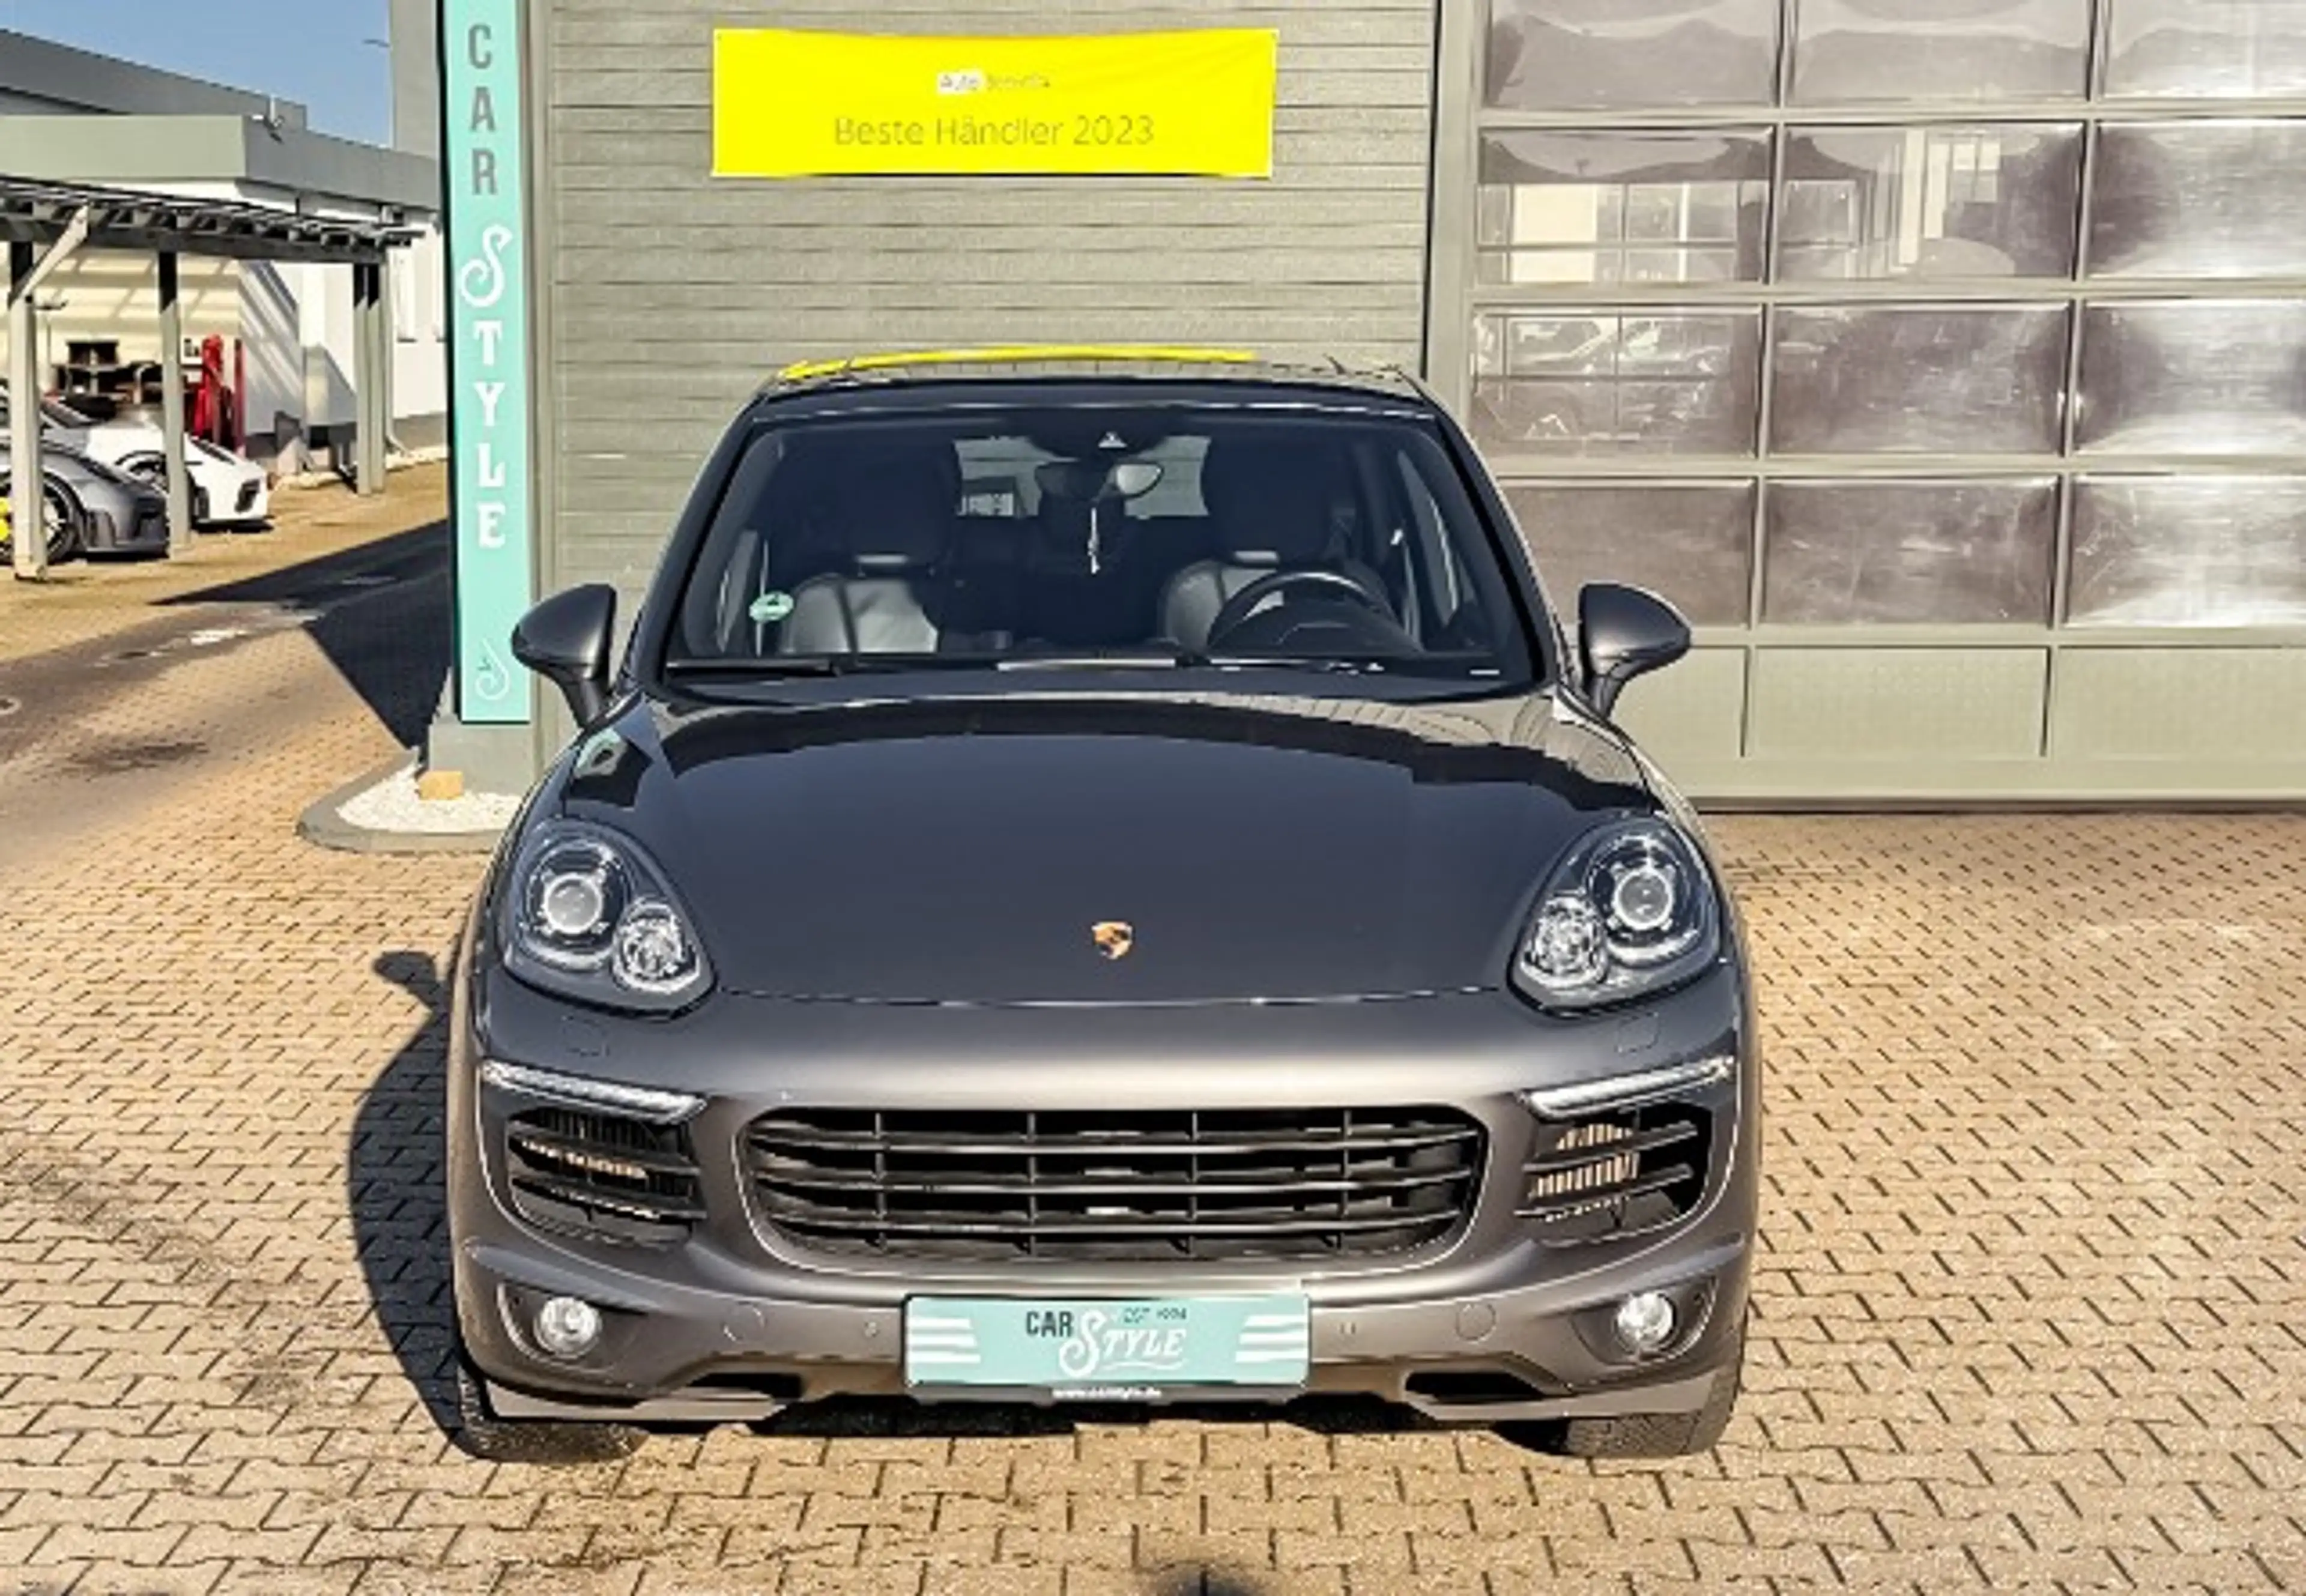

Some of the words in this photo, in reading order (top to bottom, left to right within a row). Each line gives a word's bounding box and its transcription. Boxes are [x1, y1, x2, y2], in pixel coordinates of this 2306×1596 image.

[467, 23, 497, 195] CAR
[835, 117, 924, 145] Beste
[936, 114, 1065, 145] Händler
[1073, 114, 1154, 145] 2023
[459, 223, 513, 549] STYLE
[1026, 1310, 1074, 1338] CAR
[1058, 1310, 1187, 1378] STYLE
